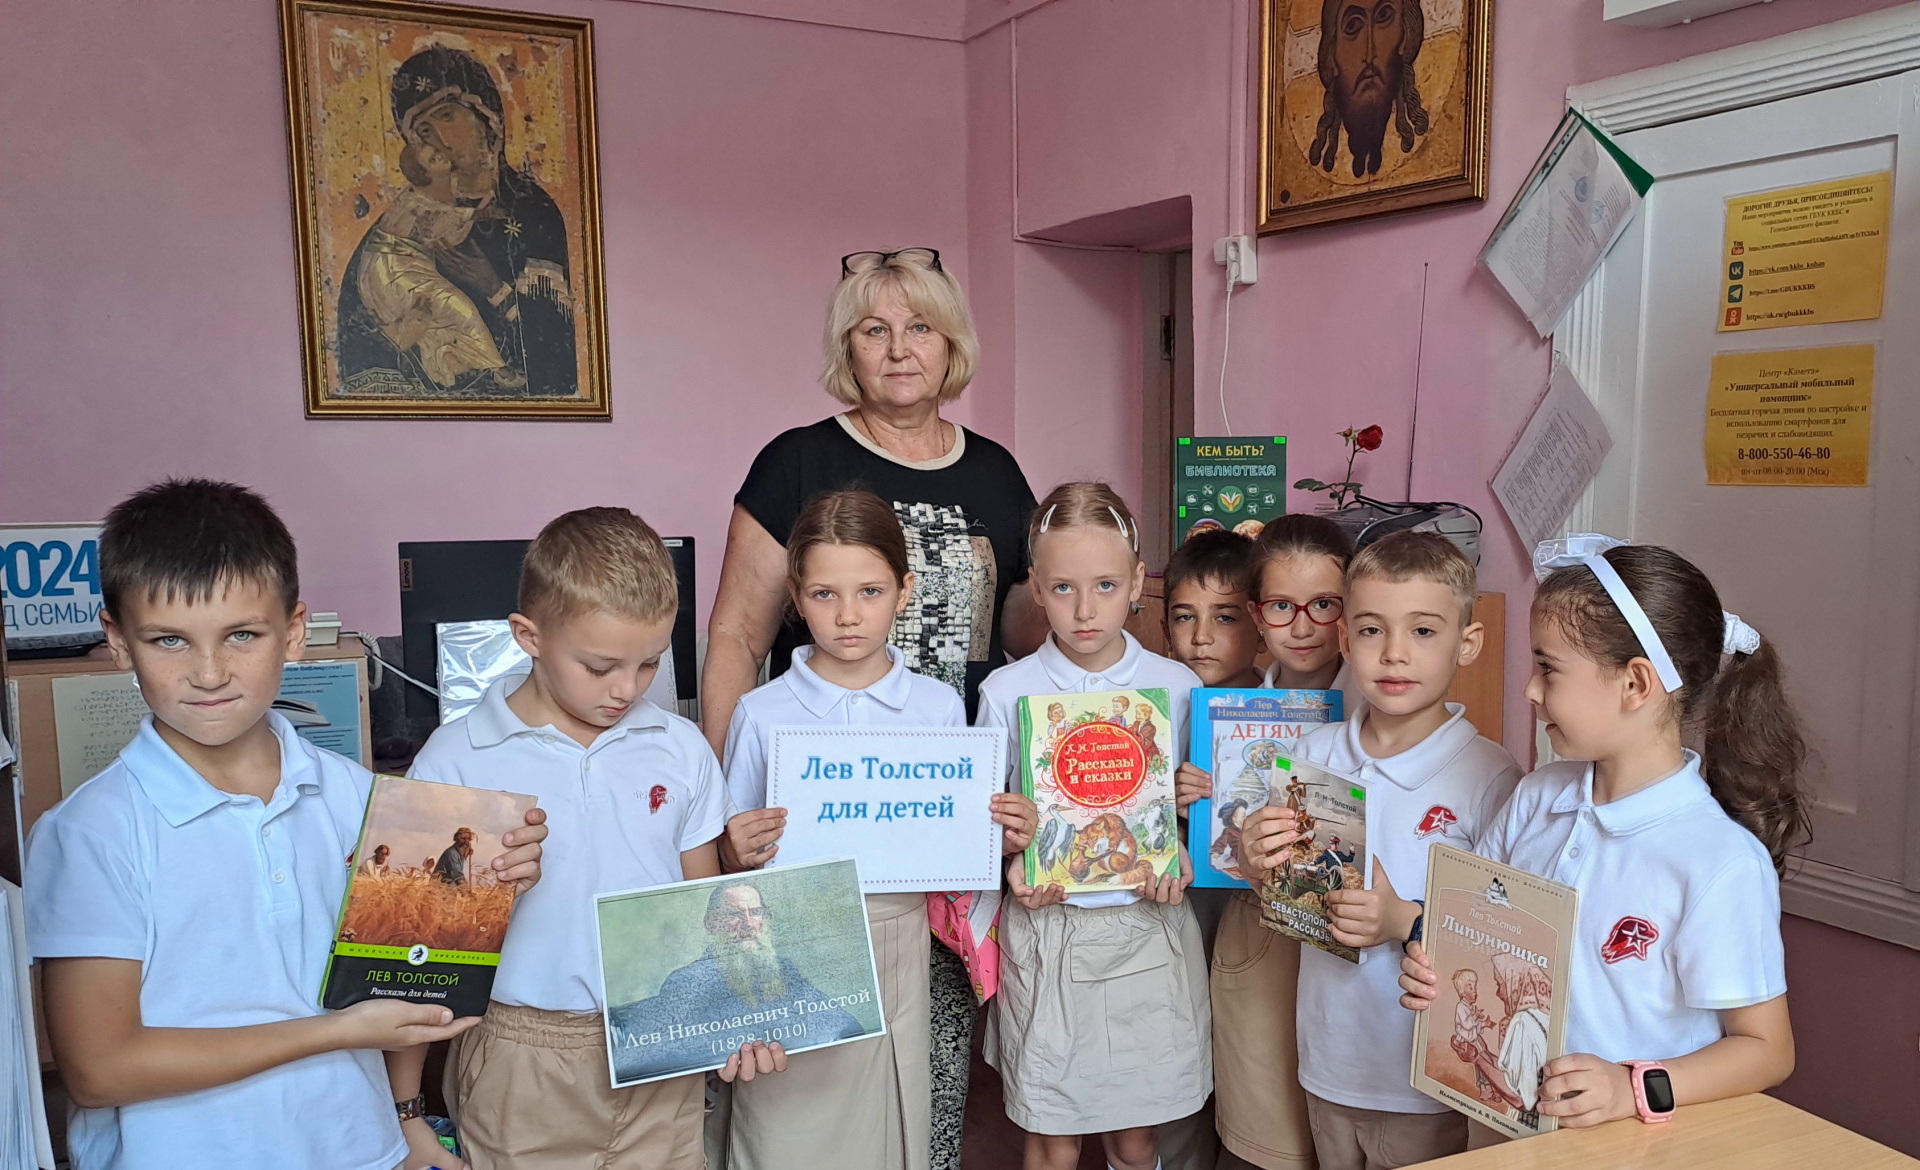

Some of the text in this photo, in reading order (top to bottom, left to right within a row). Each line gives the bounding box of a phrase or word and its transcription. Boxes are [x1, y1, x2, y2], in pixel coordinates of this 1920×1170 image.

[1742, 186, 1873, 213] ДОРОГИЕ ДРУЗЬЯ, ПРИСОЕДИНЯЙТЕСЬ!
[1725, 377, 1854, 392] «Универсальный мобильный
[1710, 408, 1750, 416] Бесплатная
[1751, 408, 1780, 417] горячая
[1818, 404, 1859, 414] настройке
[1726, 420, 1782, 428] использованию
[1784, 417, 1830, 427] смартфонов
[1197, 445, 1265, 457] КЕМ БЫТЬ?
[1738, 447, 1831, 460] 8-800-550-46-80
[1185, 464, 1277, 477] БИБЛИОТЕКА
[0, 540, 101, 598] 024
[403, 560, 411, 588] Lenovo
[1253, 700, 1273, 710] Лев
[1217, 708, 1324, 719] Николаевич Толстой
[1230, 723, 1303, 741] ДЕТЯМ
[1090, 741, 1130, 753] Толстой
[801, 756, 974, 781] Лев Толстой
[1065, 758, 1135, 775] Рассказы
[1070, 771, 1132, 784] и сказки
[817, 795, 955, 823] для детей
[1330, 797, 1357, 813] Толстой
[1271, 900, 1329, 929] СЕВАСТОПОЛЬ
[1288, 918, 1333, 942] РАССКАЗЫ
[1486, 913, 1522, 935] Толстой
[1441, 914, 1549, 969] Липунюшка
[365, 970, 460, 986] ЛЕВ ТОЛСТОЙ
[370, 986, 448, 999] Рассказы для детей
[625, 988, 871, 1049] Лев Николаевич Толстой
